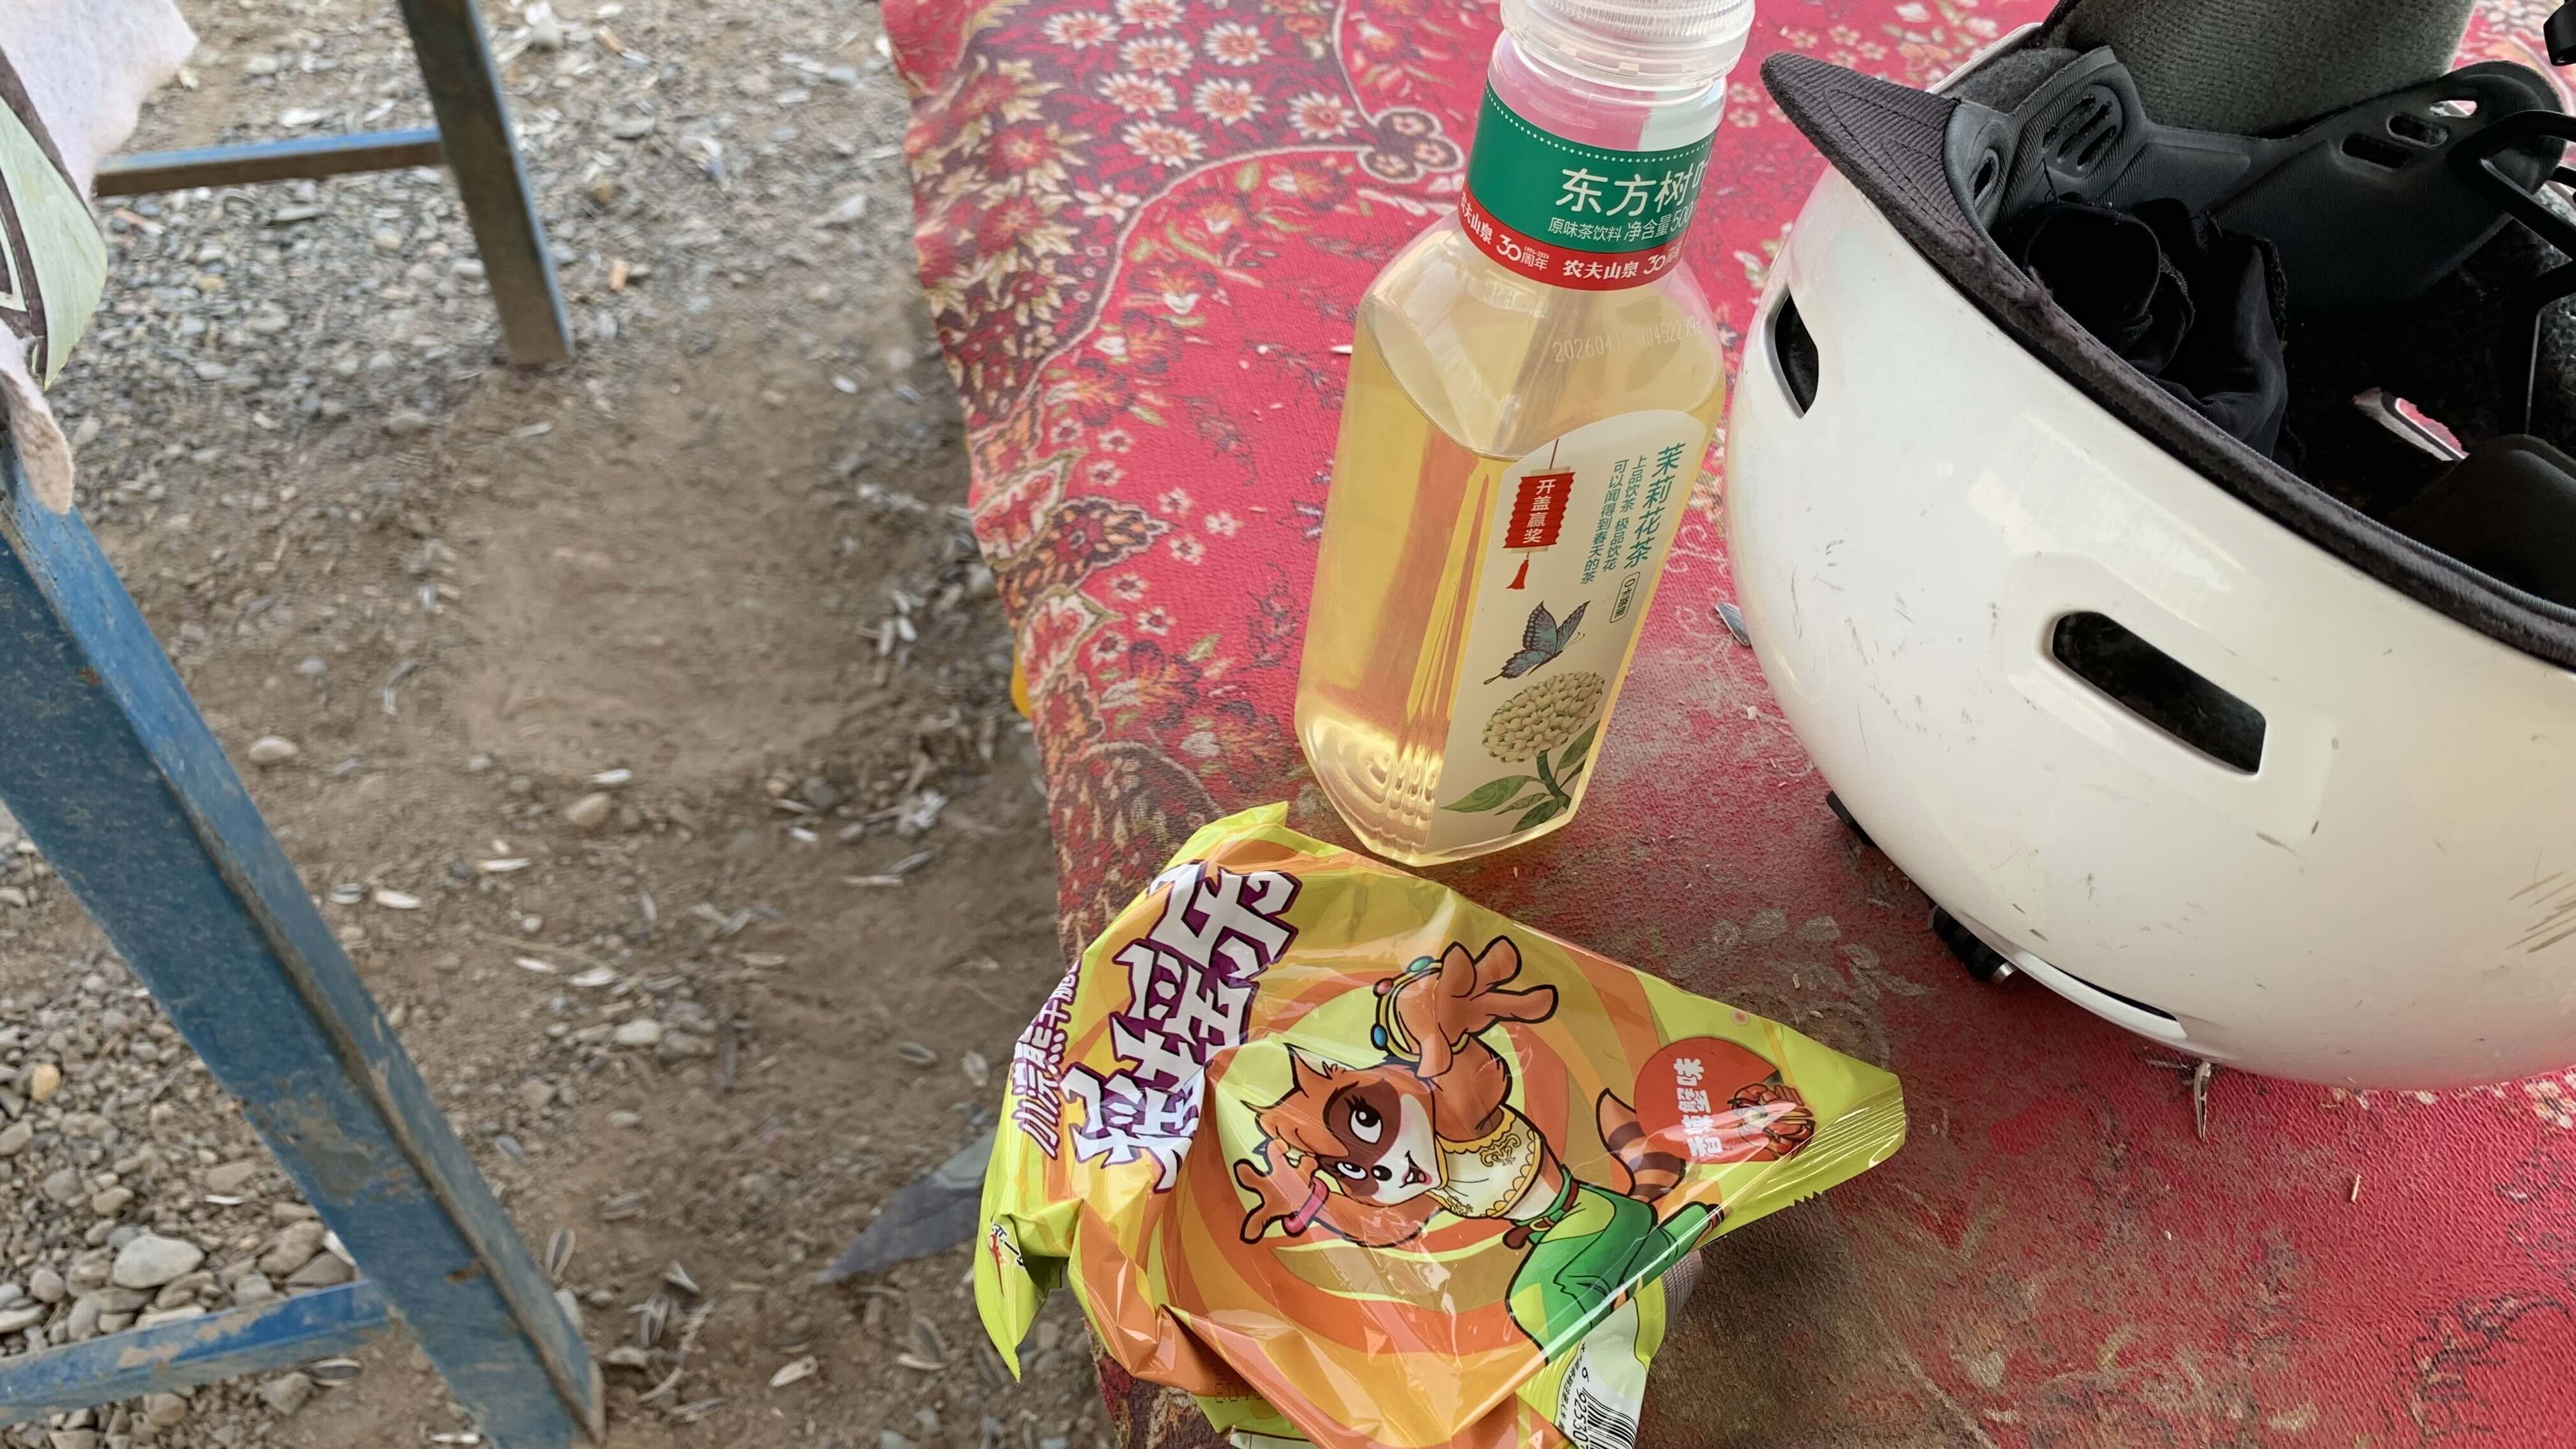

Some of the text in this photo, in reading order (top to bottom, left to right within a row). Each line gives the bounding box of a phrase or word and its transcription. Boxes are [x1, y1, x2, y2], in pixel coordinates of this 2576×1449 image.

[1547, 201, 1698, 242] 原味茶饮料 净含量500
[1563, 259, 1639, 280] 农夫山泉
[1522, 479, 1556, 544] 开盖赢奖
[1580, 459, 1629, 585] 可以闻得到春天的茶
[1603, 454, 1647, 572] 上品饮茶 极品饮花
[1623, 442, 1686, 569] 茉莉花茶
[1058, 860, 1302, 1194] 摇摇乐
[1673, 1058, 1723, 1157] 香辣蟹味
[1573, 1388, 1589, 1449] 92530
